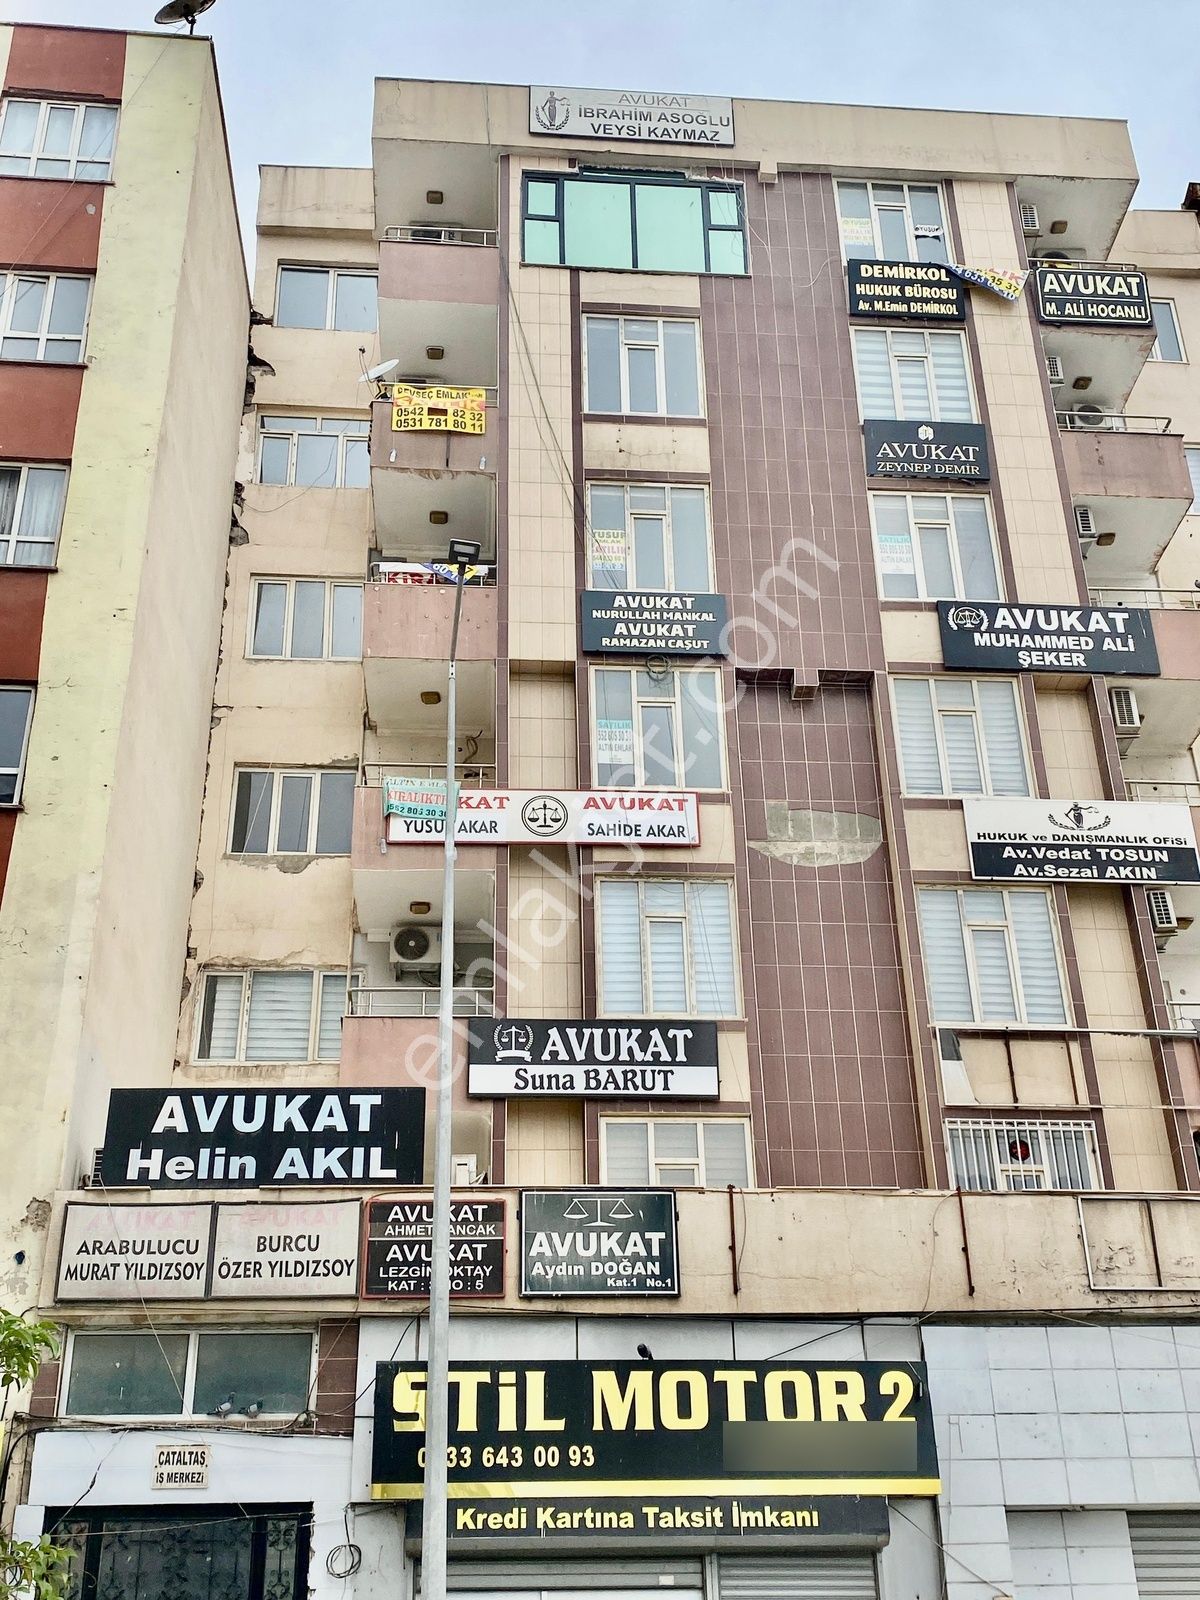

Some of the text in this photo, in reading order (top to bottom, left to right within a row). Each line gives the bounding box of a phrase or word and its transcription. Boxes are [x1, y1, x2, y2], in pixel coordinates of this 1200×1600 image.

[618, 93, 691, 108] AVUKAT
[590, 123, 720, 142] VEYSİ KAYMAZ
[860, 263, 950, 281] DEMİRKOL
[855, 283, 958, 300] HUKUK BÜROSU
[1043, 273, 1142, 297] AVUKAT
[858, 299, 872, 311] Av.
[874, 300, 908, 312] M.Emin
[1046, 299, 1146, 319] M. ALİ HOCANLI
[397, 407, 483, 422] 0542 82 32
[396, 417, 483, 432] 0531 781 80 11
[876, 442, 979, 462] AVUKAT
[877, 461, 980, 475] ZEYNEP DEMİR
[612, 595, 696, 610] AVUKAT
[592, 609, 717, 621] NURULLAH MANKAL
[993, 607, 1130, 634] AVUKAT
[614, 622, 697, 637] AVUKAT
[601, 637, 710, 651] RAMAZAN CAŞUT
[973, 632, 1135, 652] MUHAMMED ALİ
[1017, 650, 1087, 668] ŞEKER
[457, 796, 510, 809] KAT
[583, 796, 689, 811] AVUKAT
[425, 808, 437, 817] 30
[404, 819, 499, 834] YUSU AKAR
[587, 820, 686, 838] SAHİDE AKAR
[977, 832, 1028, 842] HUKUK
[1032, 834, 1047, 842] ve
[1052, 833, 1149, 845] DANIŞMANLIK
[1002, 846, 1169, 863] Av.Vedat TOSUN
[1013, 863, 1158, 880] Av.Sezai AKIN
[541, 1026, 693, 1063] AVUKAT
[514, 1067, 675, 1092] Suna BARUT
[150, 1094, 382, 1133] AVUKAT
[126, 1146, 397, 1181] Helin AKIL
[384, 1224, 496, 1236] AHMET ANCAK
[76, 1239, 200, 1256] ARABULUCU
[256, 1234, 321, 1253] BURCU
[528, 1231, 666, 1257] AVUKAT
[64, 1262, 205, 1281] MURAT YILDIZSOY
[217, 1257, 355, 1280] ÖZER YILDIZSOY
[531, 1258, 660, 1279] Aydın DOĞAN
[387, 1280, 417, 1291] KAT
[475, 1280, 484, 1291] 5
[607, 1278, 672, 1287] Kat.1 No.1
[592, 1370, 868, 1430] MOTOR
[879, 1370, 916, 1422] 2
[417, 1445, 595, 1468] 033 643 00 93
[456, 1501, 819, 1530] Kredi Kartına Taksit İmkanı
